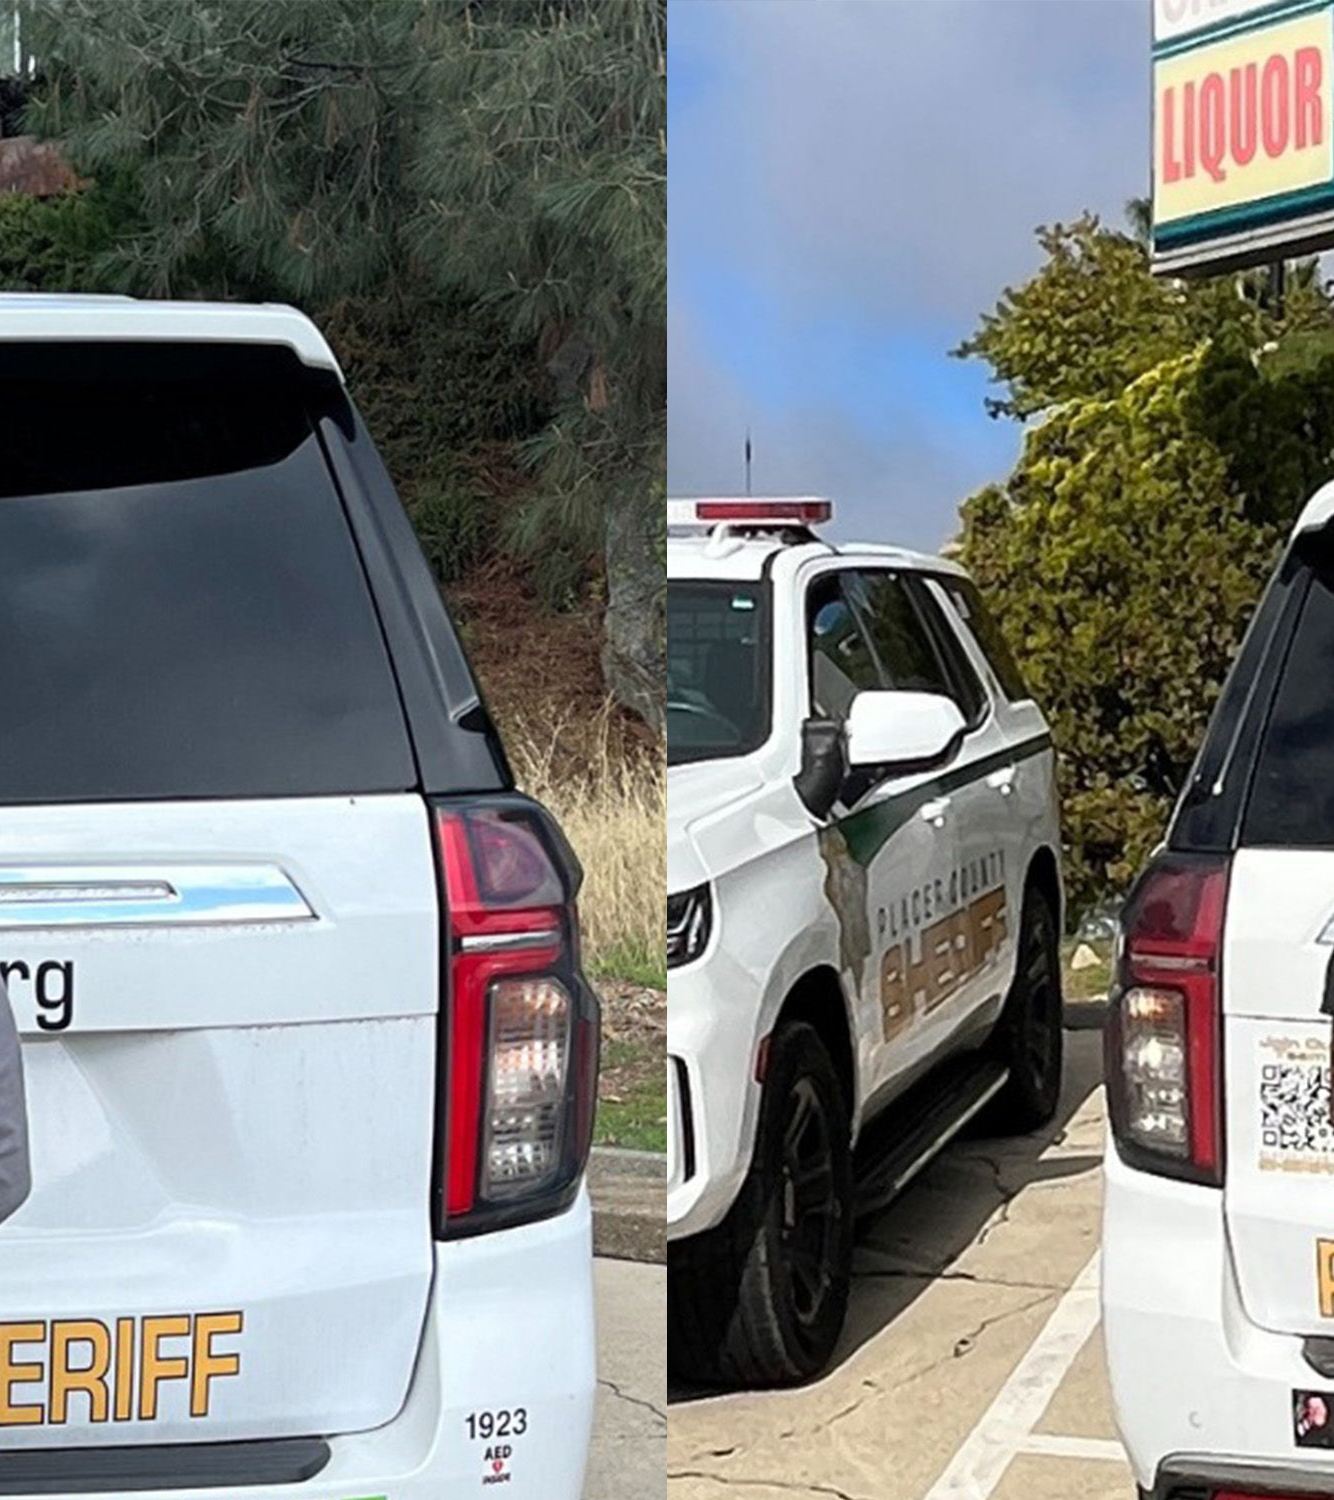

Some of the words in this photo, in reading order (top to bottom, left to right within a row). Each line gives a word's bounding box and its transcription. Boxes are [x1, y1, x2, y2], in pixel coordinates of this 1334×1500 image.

[1163, 46, 1323, 184] LIQUOR
[466, 1408, 527, 1440] 1923
[484, 1444, 513, 1461] AED
